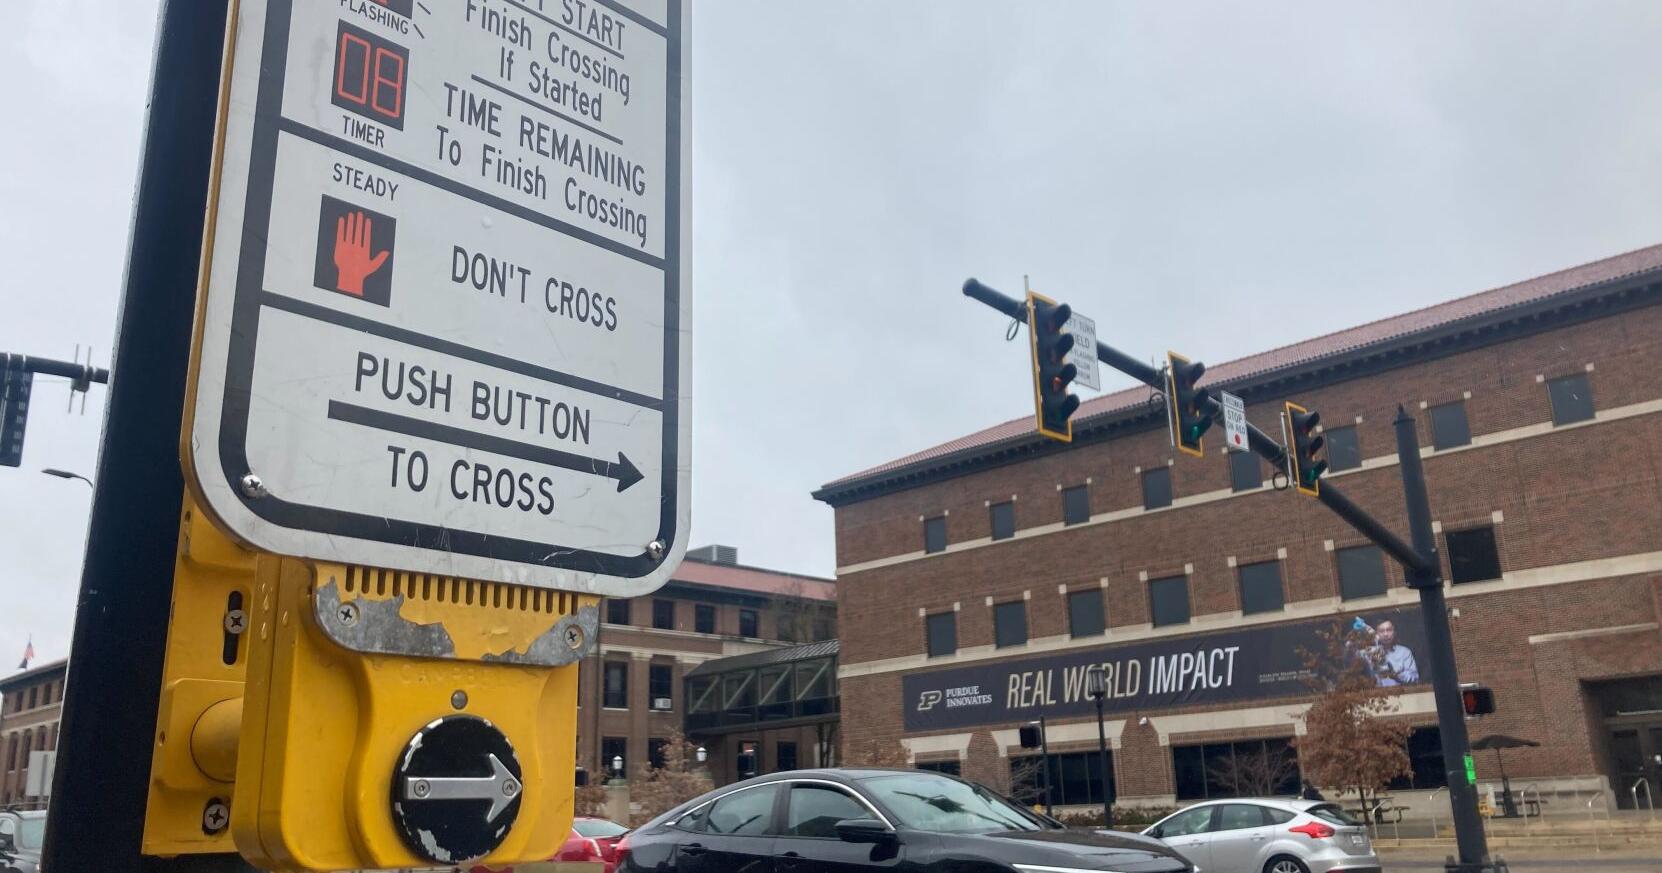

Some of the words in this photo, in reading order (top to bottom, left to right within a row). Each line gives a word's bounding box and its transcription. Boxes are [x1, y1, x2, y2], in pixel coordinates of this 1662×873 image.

[466, 0, 532, 50] Finish
[547, 31, 630, 105] Crossing
[562, 0, 626, 50] START
[337, 31, 404, 118] 08
[500, 46, 515, 82] If
[529, 61, 602, 122] Started
[342, 114, 385, 148] TIMER
[443, 81, 501, 138] TIME
[520, 115, 647, 197] REMAINING
[332, 162, 400, 202] STEADY
[436, 125, 462, 167] To
[481, 144, 547, 200] Finish
[564, 176, 648, 247] Crossing
[451, 245, 532, 303] DON'T
[545, 277, 618, 332] CROSS
[354, 350, 453, 414] PUSH
[471, 380, 591, 445] BUTTON
[386, 445, 429, 493] TO
[450, 459, 555, 516] CROSS
[945, 685, 980, 698] PURDUE
[946, 694, 993, 708] INNOVATES
[1006, 669, 1057, 710] REAL
[1148, 646, 1240, 696] IMPACT
